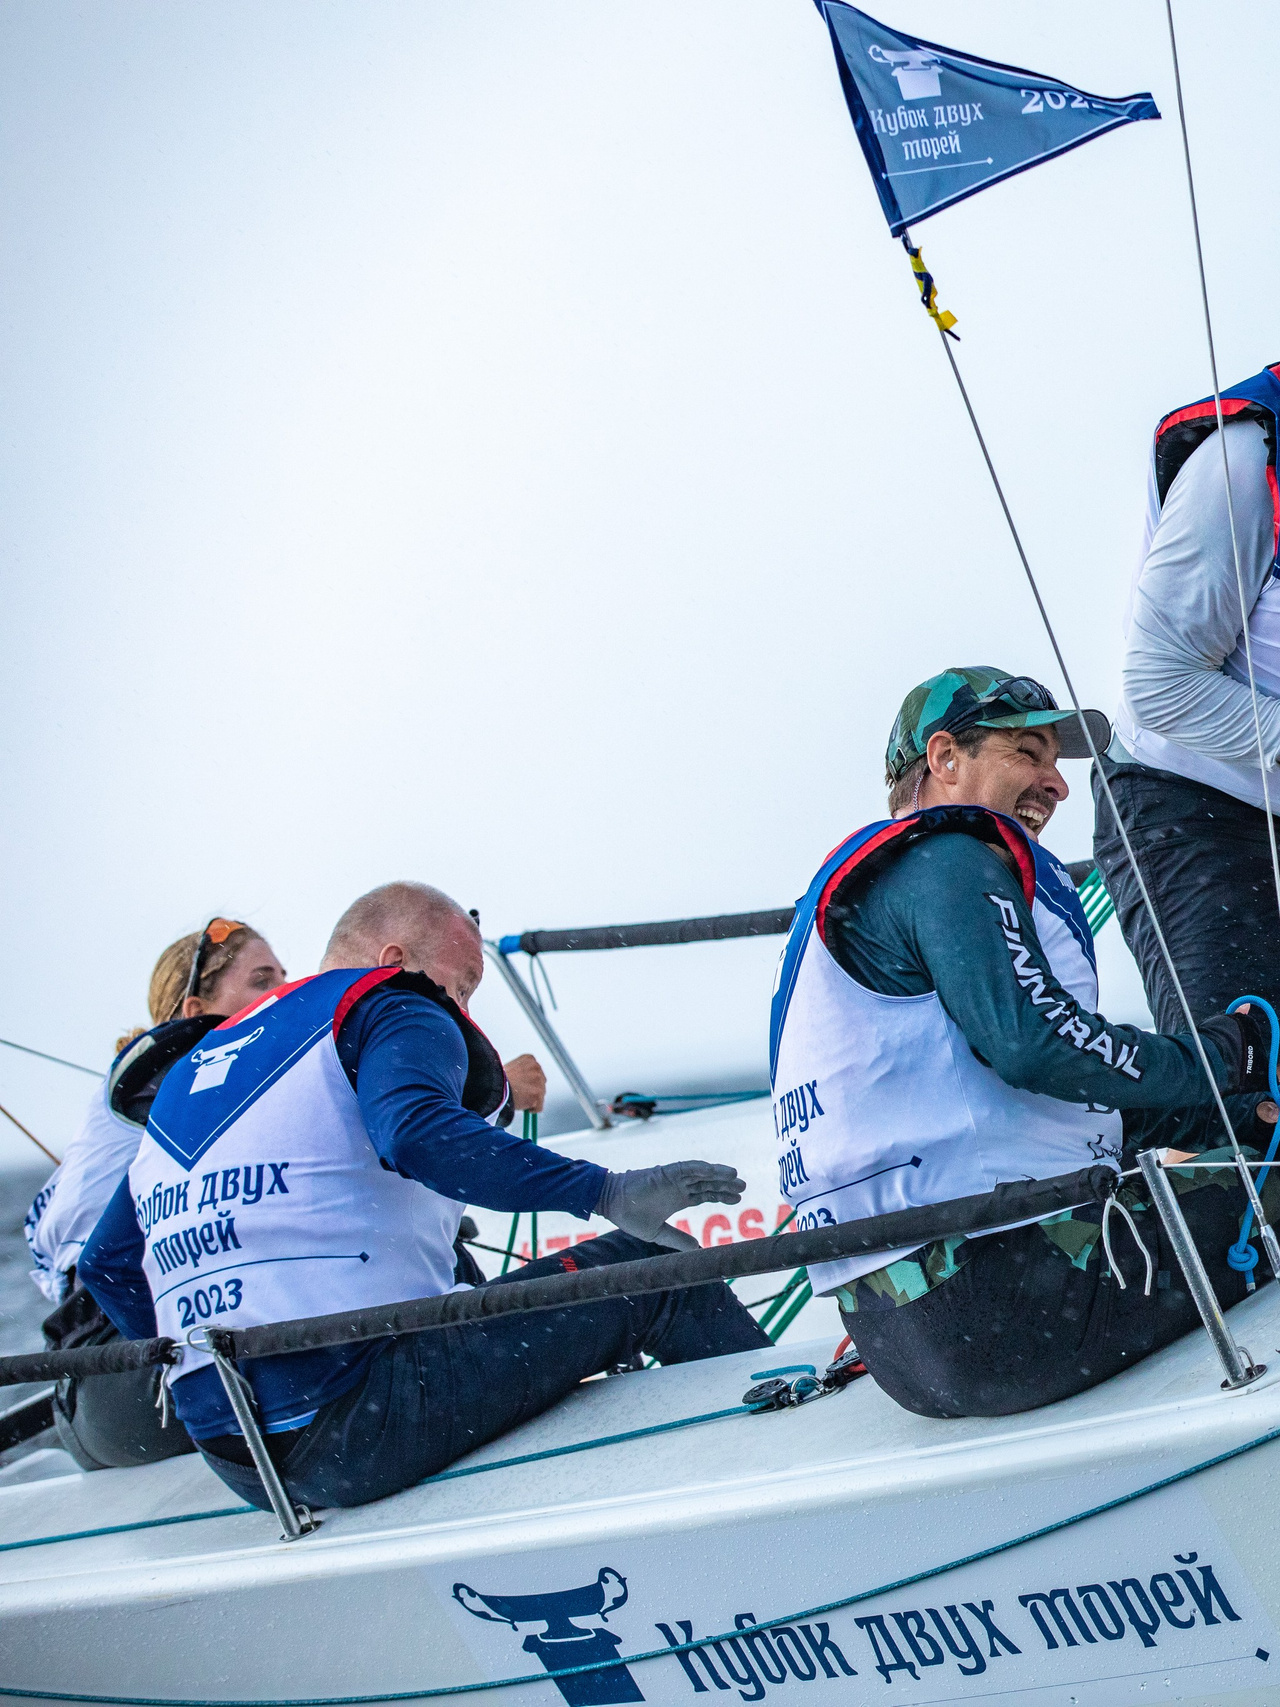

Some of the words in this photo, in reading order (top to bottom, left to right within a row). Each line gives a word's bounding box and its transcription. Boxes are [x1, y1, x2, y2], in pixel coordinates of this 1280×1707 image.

[870, 104, 928, 135] Кубок
[933, 103, 984, 128] двух
[1020, 89, 1106, 115] 202
[987, 893, 1142, 1081] FINNTRAIL
[1246, 1045, 1254, 1074] TRIBORD
[779, 1079, 825, 1142] двух
[197, 1161, 290, 1214] двух
[177, 1278, 244, 1329] 2023
[654, 1612, 858, 1702] Кубок
[853, 1597, 1023, 1684] двух
